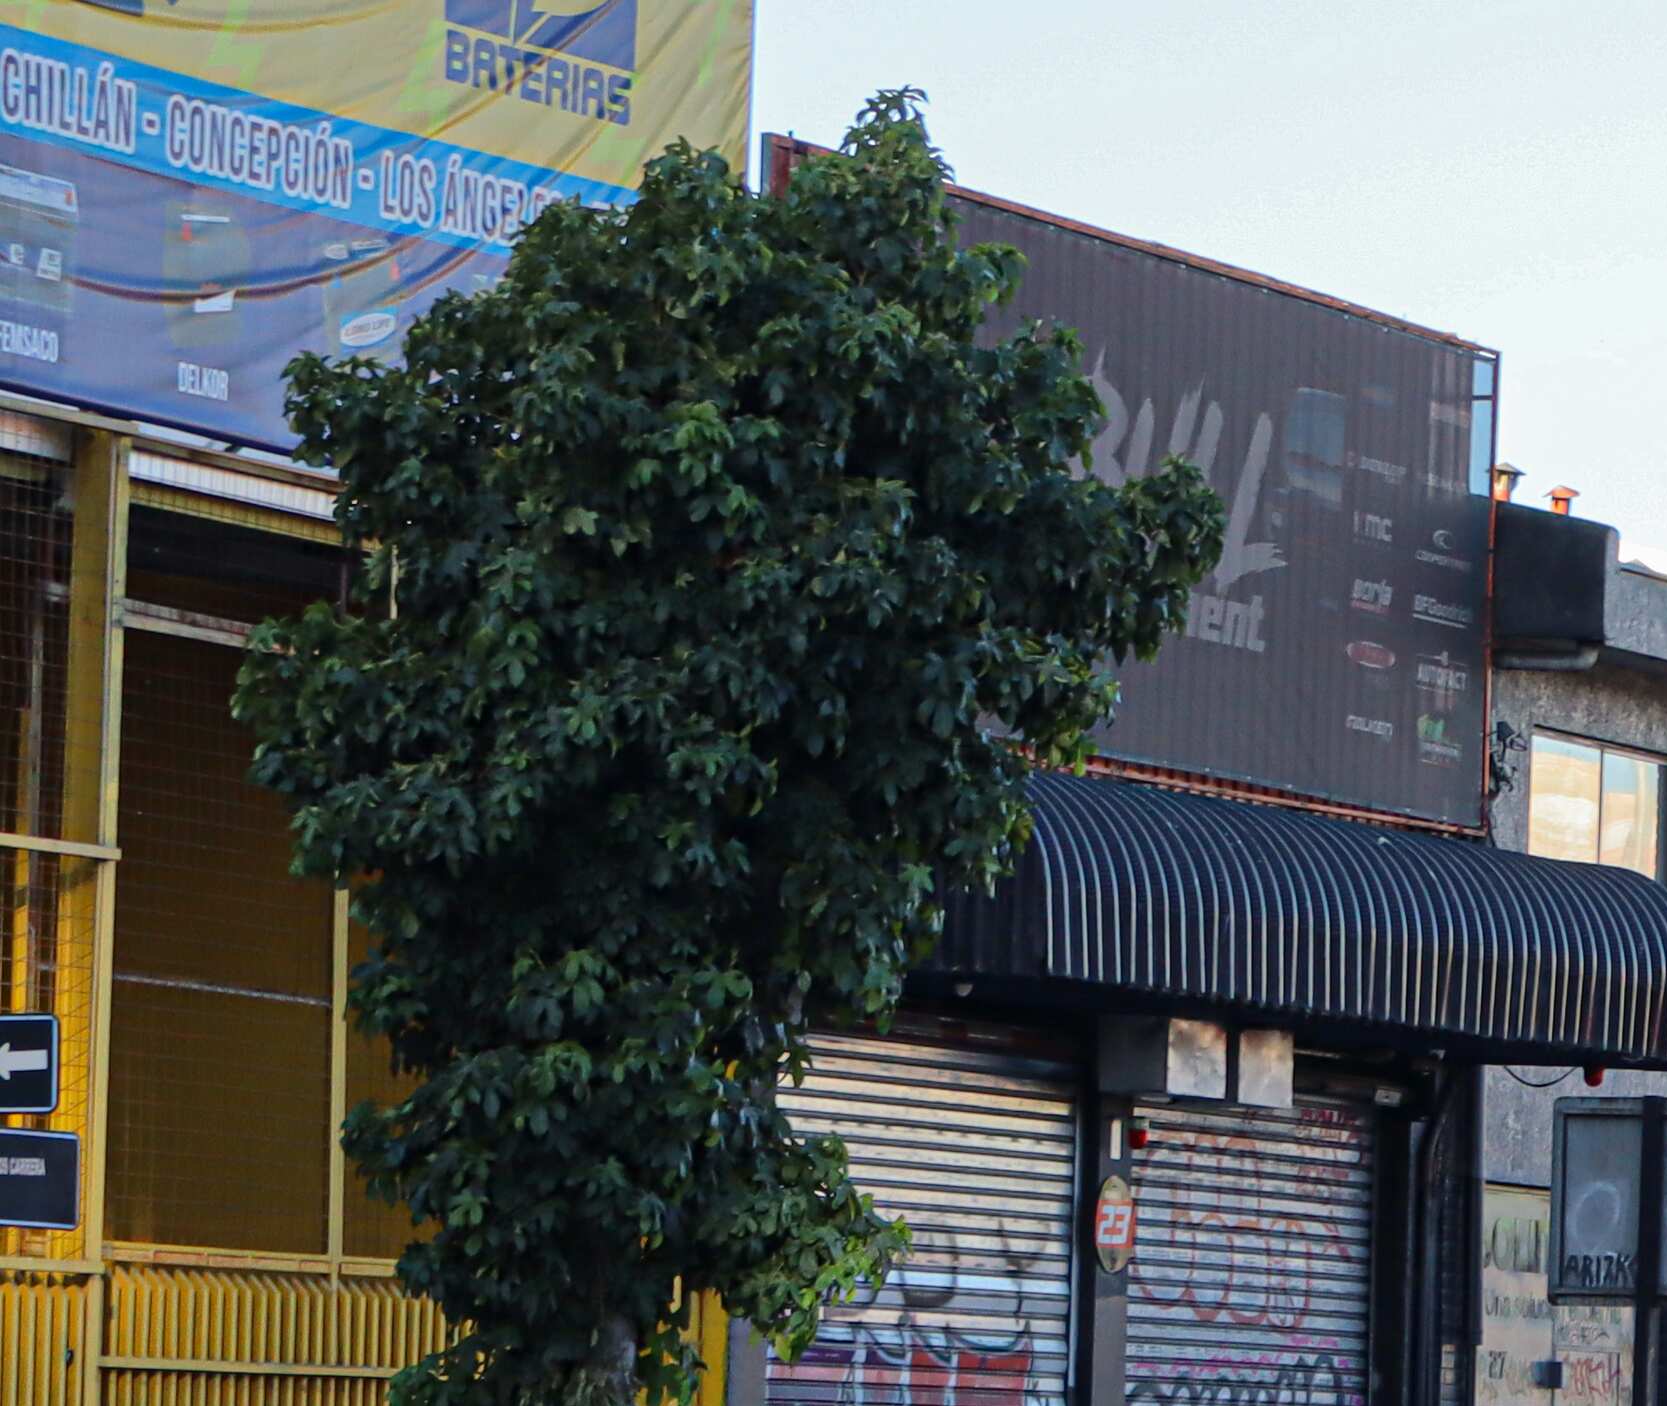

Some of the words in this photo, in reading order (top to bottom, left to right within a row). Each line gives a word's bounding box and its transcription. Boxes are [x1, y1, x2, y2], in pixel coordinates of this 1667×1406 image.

[445, 28, 632, 127] BATERIAS
[1, 48, 137, 155] CHILLÁN
[166, 94, 353, 208] CONCEPCIÓN
[380, 149, 437, 230] LOS
[178, 361, 229, 401] DELKOR
[1097, 1204, 1133, 1244] 23
